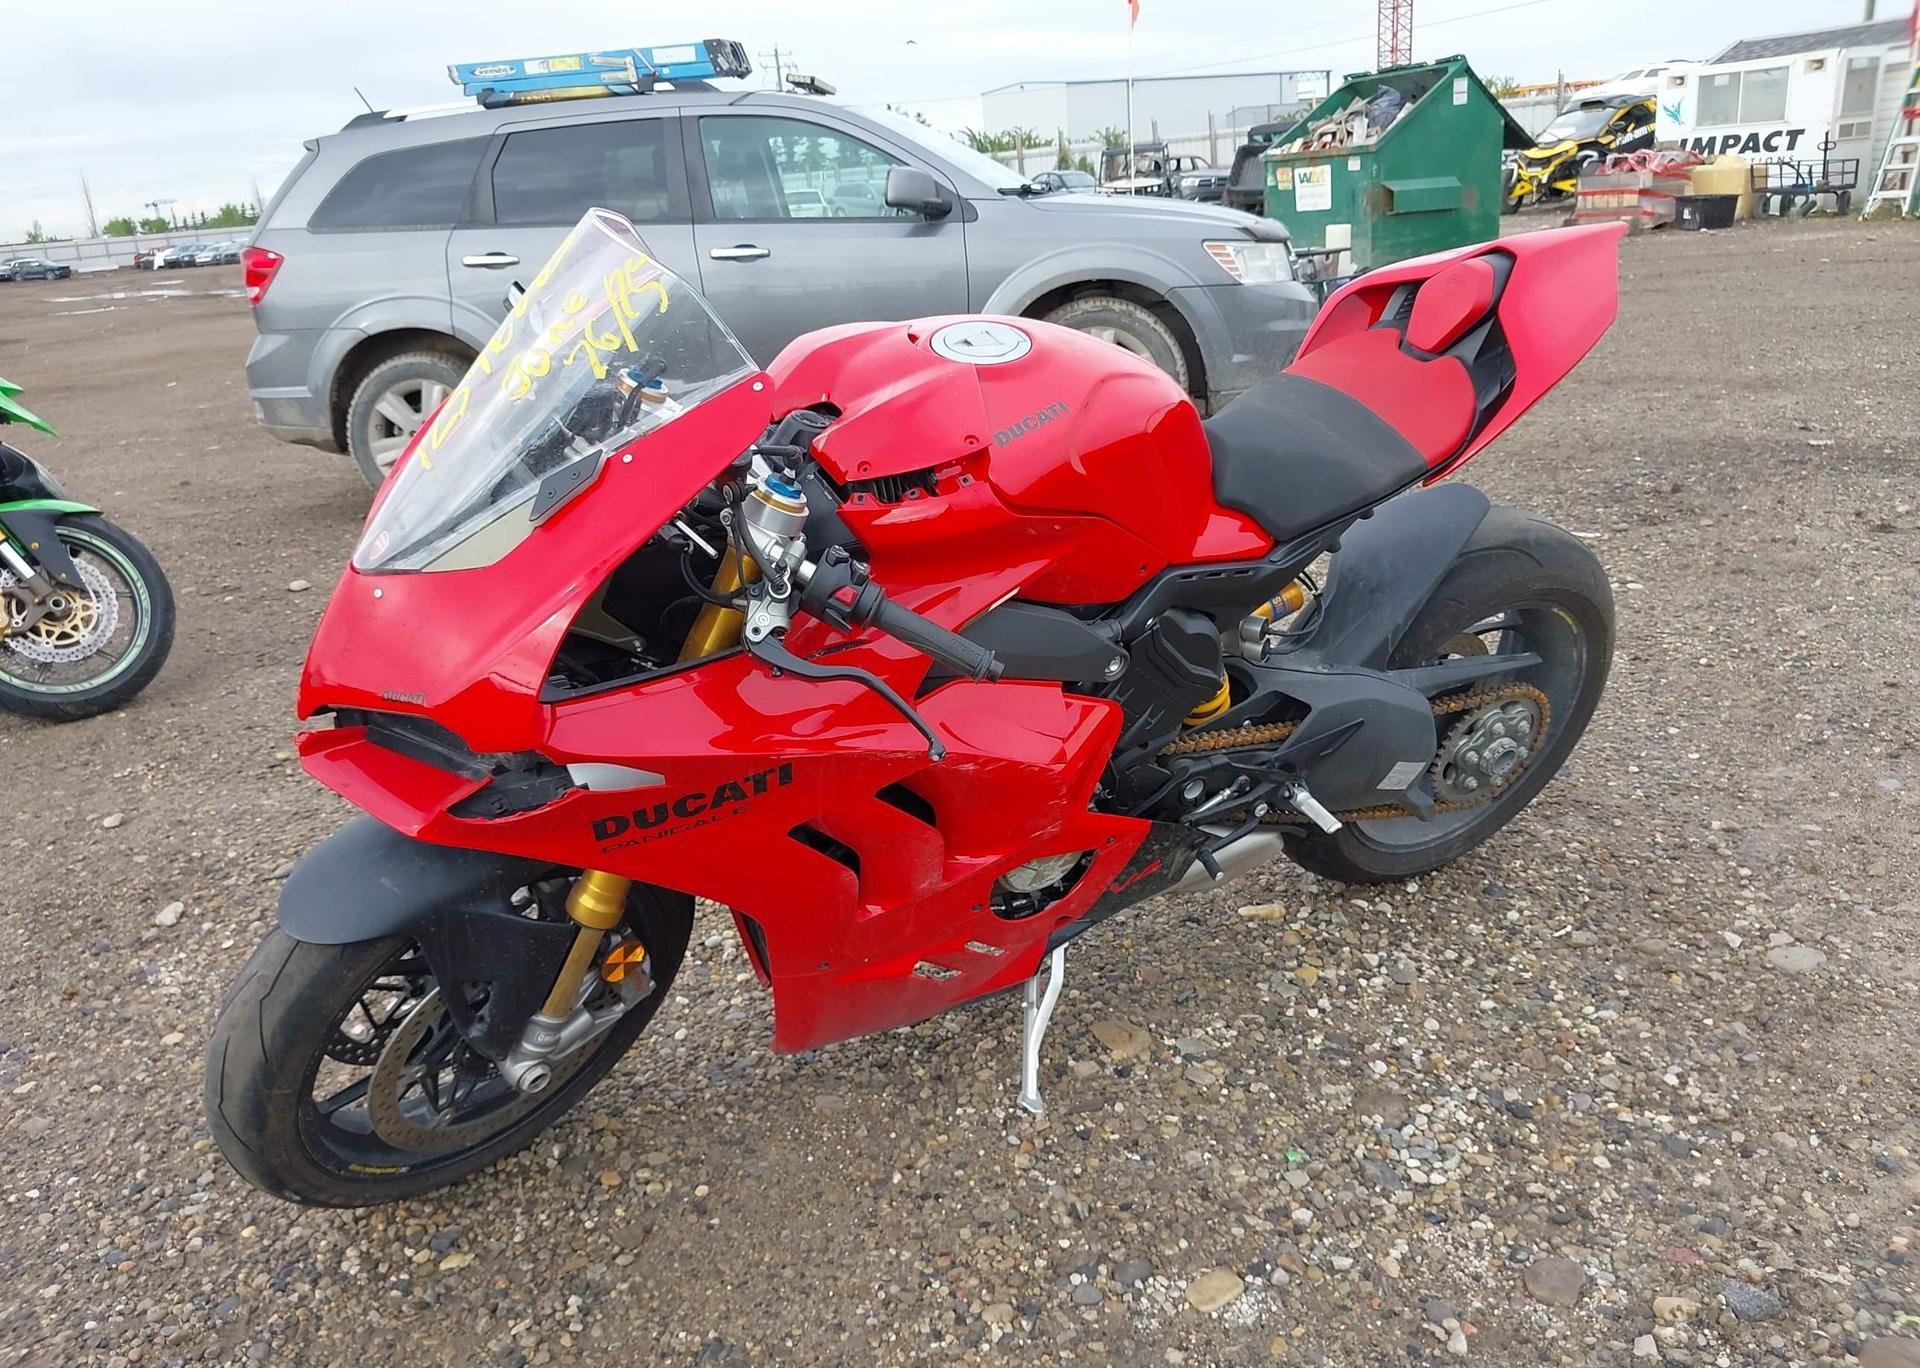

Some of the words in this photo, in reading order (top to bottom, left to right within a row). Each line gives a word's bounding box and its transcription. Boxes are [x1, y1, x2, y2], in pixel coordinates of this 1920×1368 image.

[1680, 128, 1806, 156] IMPACT
[992, 400, 1070, 447] DUCATI
[382, 689, 428, 706] DUCATI
[592, 762, 794, 842] DUCATI
